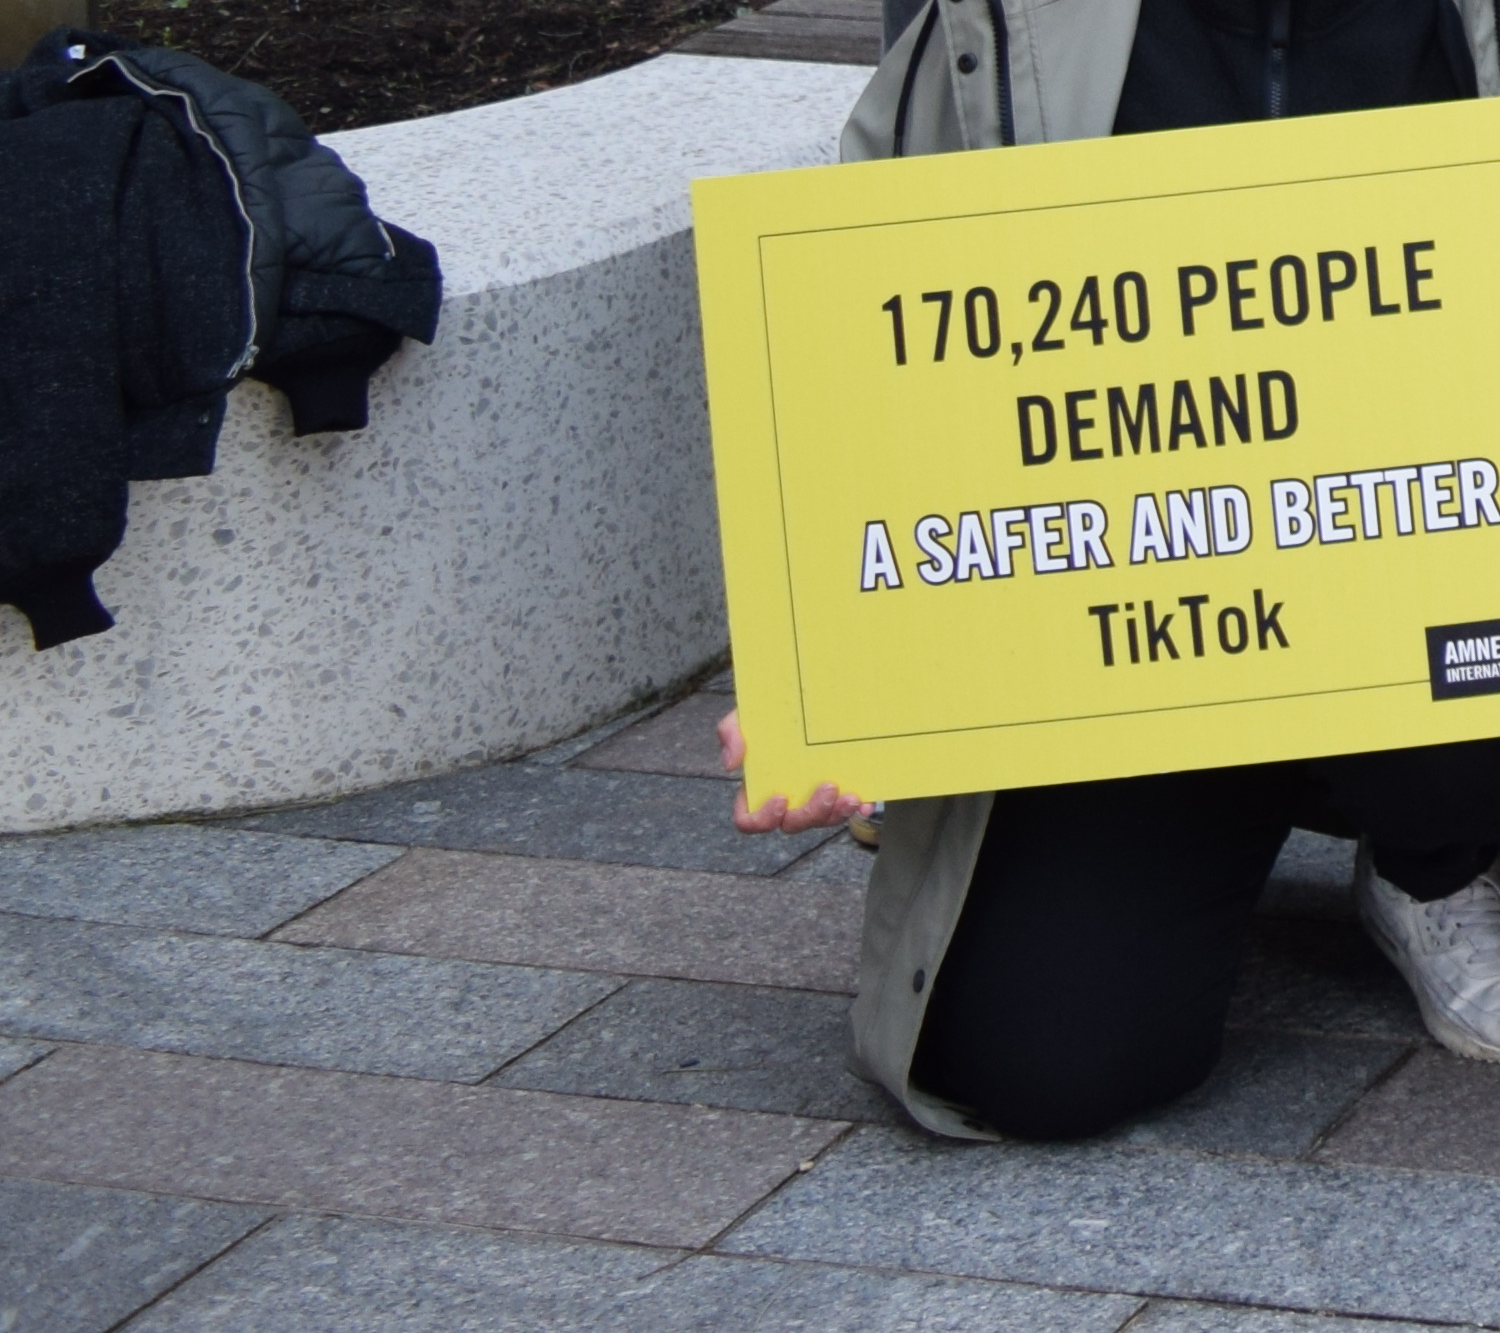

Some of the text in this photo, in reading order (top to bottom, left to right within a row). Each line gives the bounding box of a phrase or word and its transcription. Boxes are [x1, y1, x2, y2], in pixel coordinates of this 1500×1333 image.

[881, 239, 1442, 367] 170,240 PEOPLE
[1016, 369, 1299, 467] DEMAND
[859, 519, 905, 593] A
[913, 499, 1116, 587] SAFER
[1128, 483, 1254, 566] AND
[1087, 588, 1290, 667] TikTok
